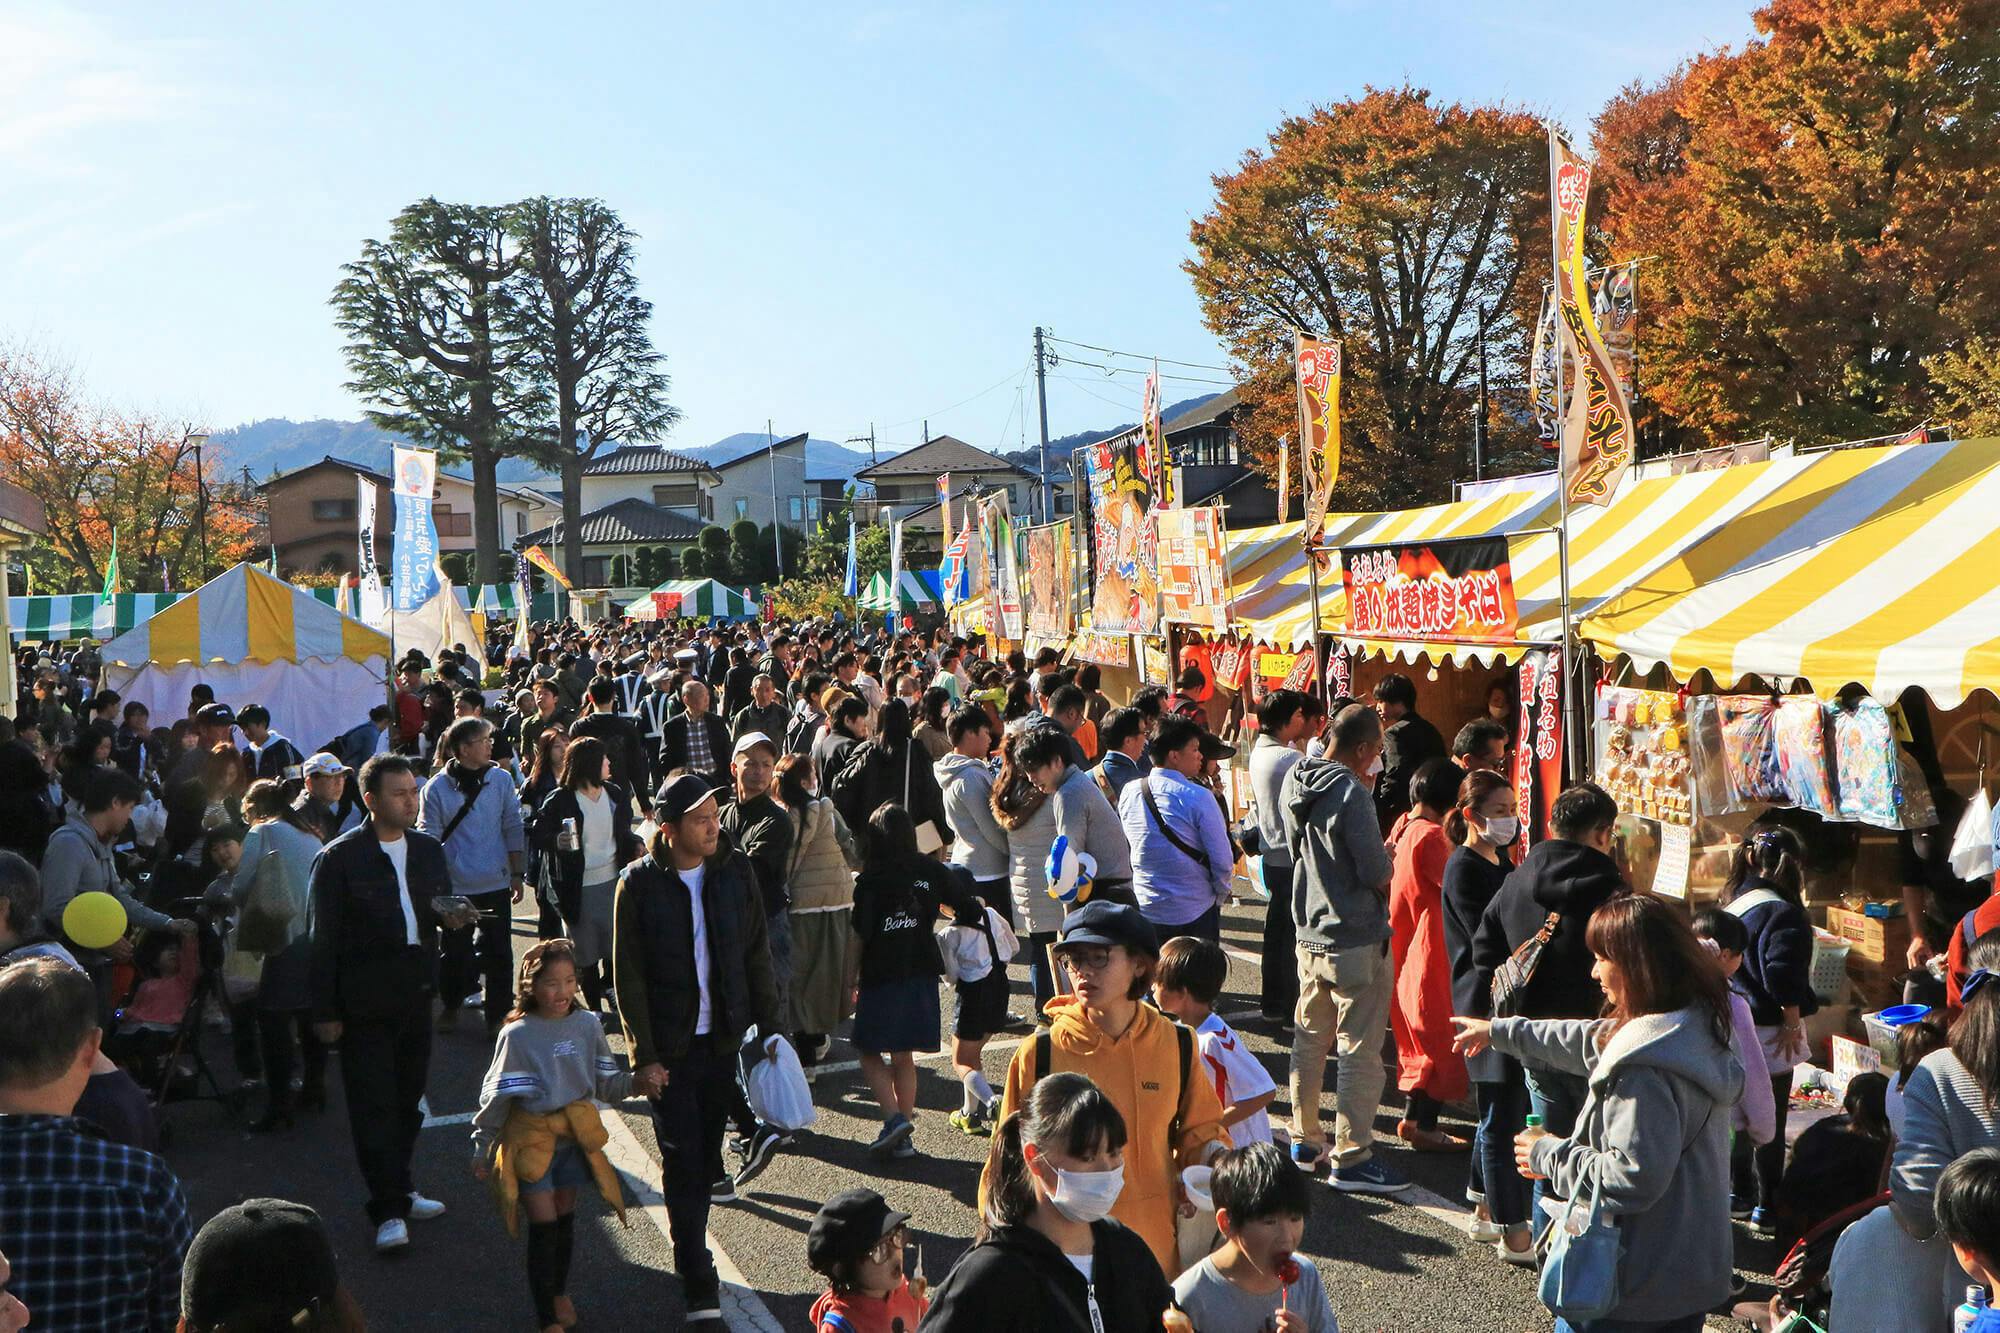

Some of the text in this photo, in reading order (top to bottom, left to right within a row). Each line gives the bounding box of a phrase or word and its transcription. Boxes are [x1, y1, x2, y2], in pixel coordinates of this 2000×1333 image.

[1351, 550, 1398, 586] 元祖名物
[1353, 569, 1506, 635] 盛り放題焼きそば
[1536, 645, 1560, 760] 元祖名物
[1141, 1081, 1160, 1091] VANS
